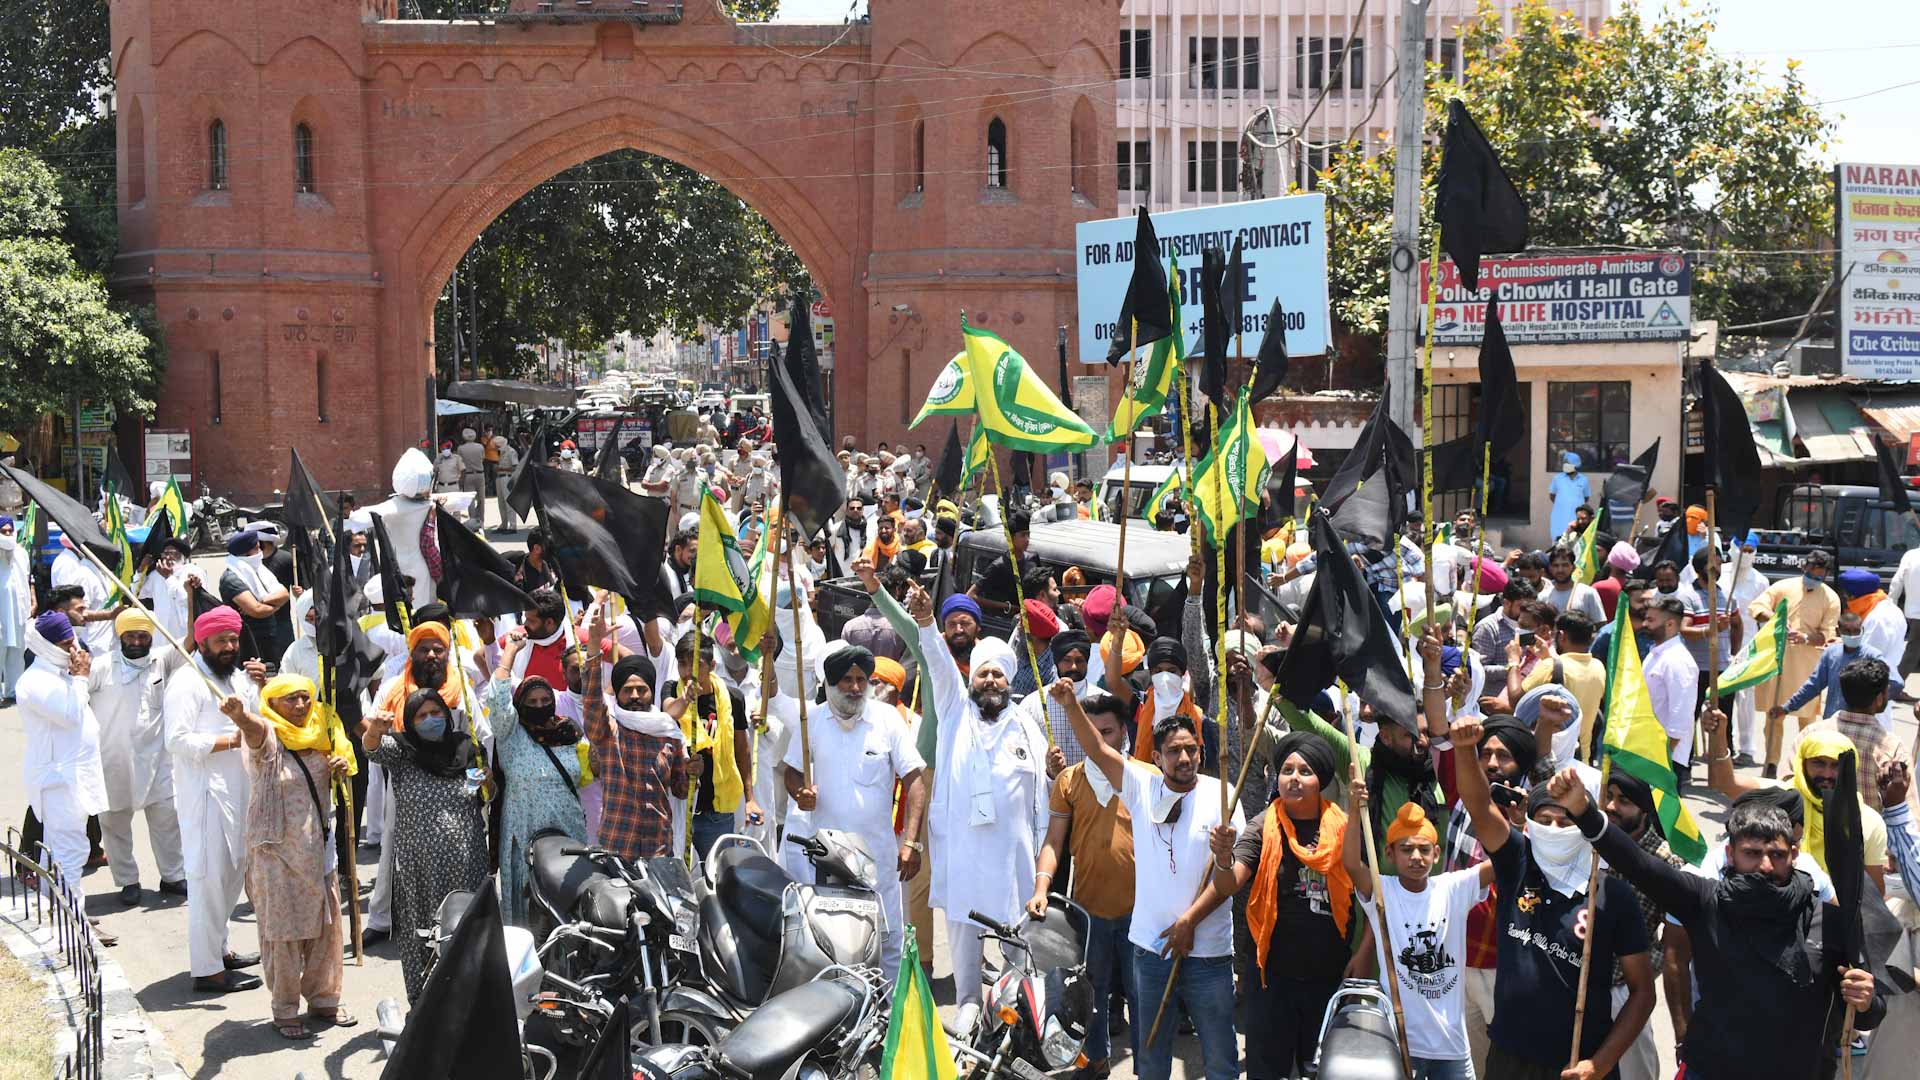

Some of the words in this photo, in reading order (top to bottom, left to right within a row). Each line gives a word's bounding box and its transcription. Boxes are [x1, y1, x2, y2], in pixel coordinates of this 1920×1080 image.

[1085, 244, 1110, 265] FOR
[1116, 230, 1232, 262] ADTISEMENT
[1238, 220, 1312, 251] CONTACT
[1492, 261, 1597, 279] Commissionerate
[1600, 259, 1655, 275] Amritsar
[1498, 279, 1573, 301] Chowki
[1580, 278, 1622, 298] Hall
[1629, 277, 1679, 297] Gate
[1510, 303, 1546, 322] LIFE
[1551, 300, 1645, 321] HOSPITAL
[1561, 321, 1578, 330] With
[1852, 336, 1879, 351] The
[1548, 942, 1568, 959] Polo
